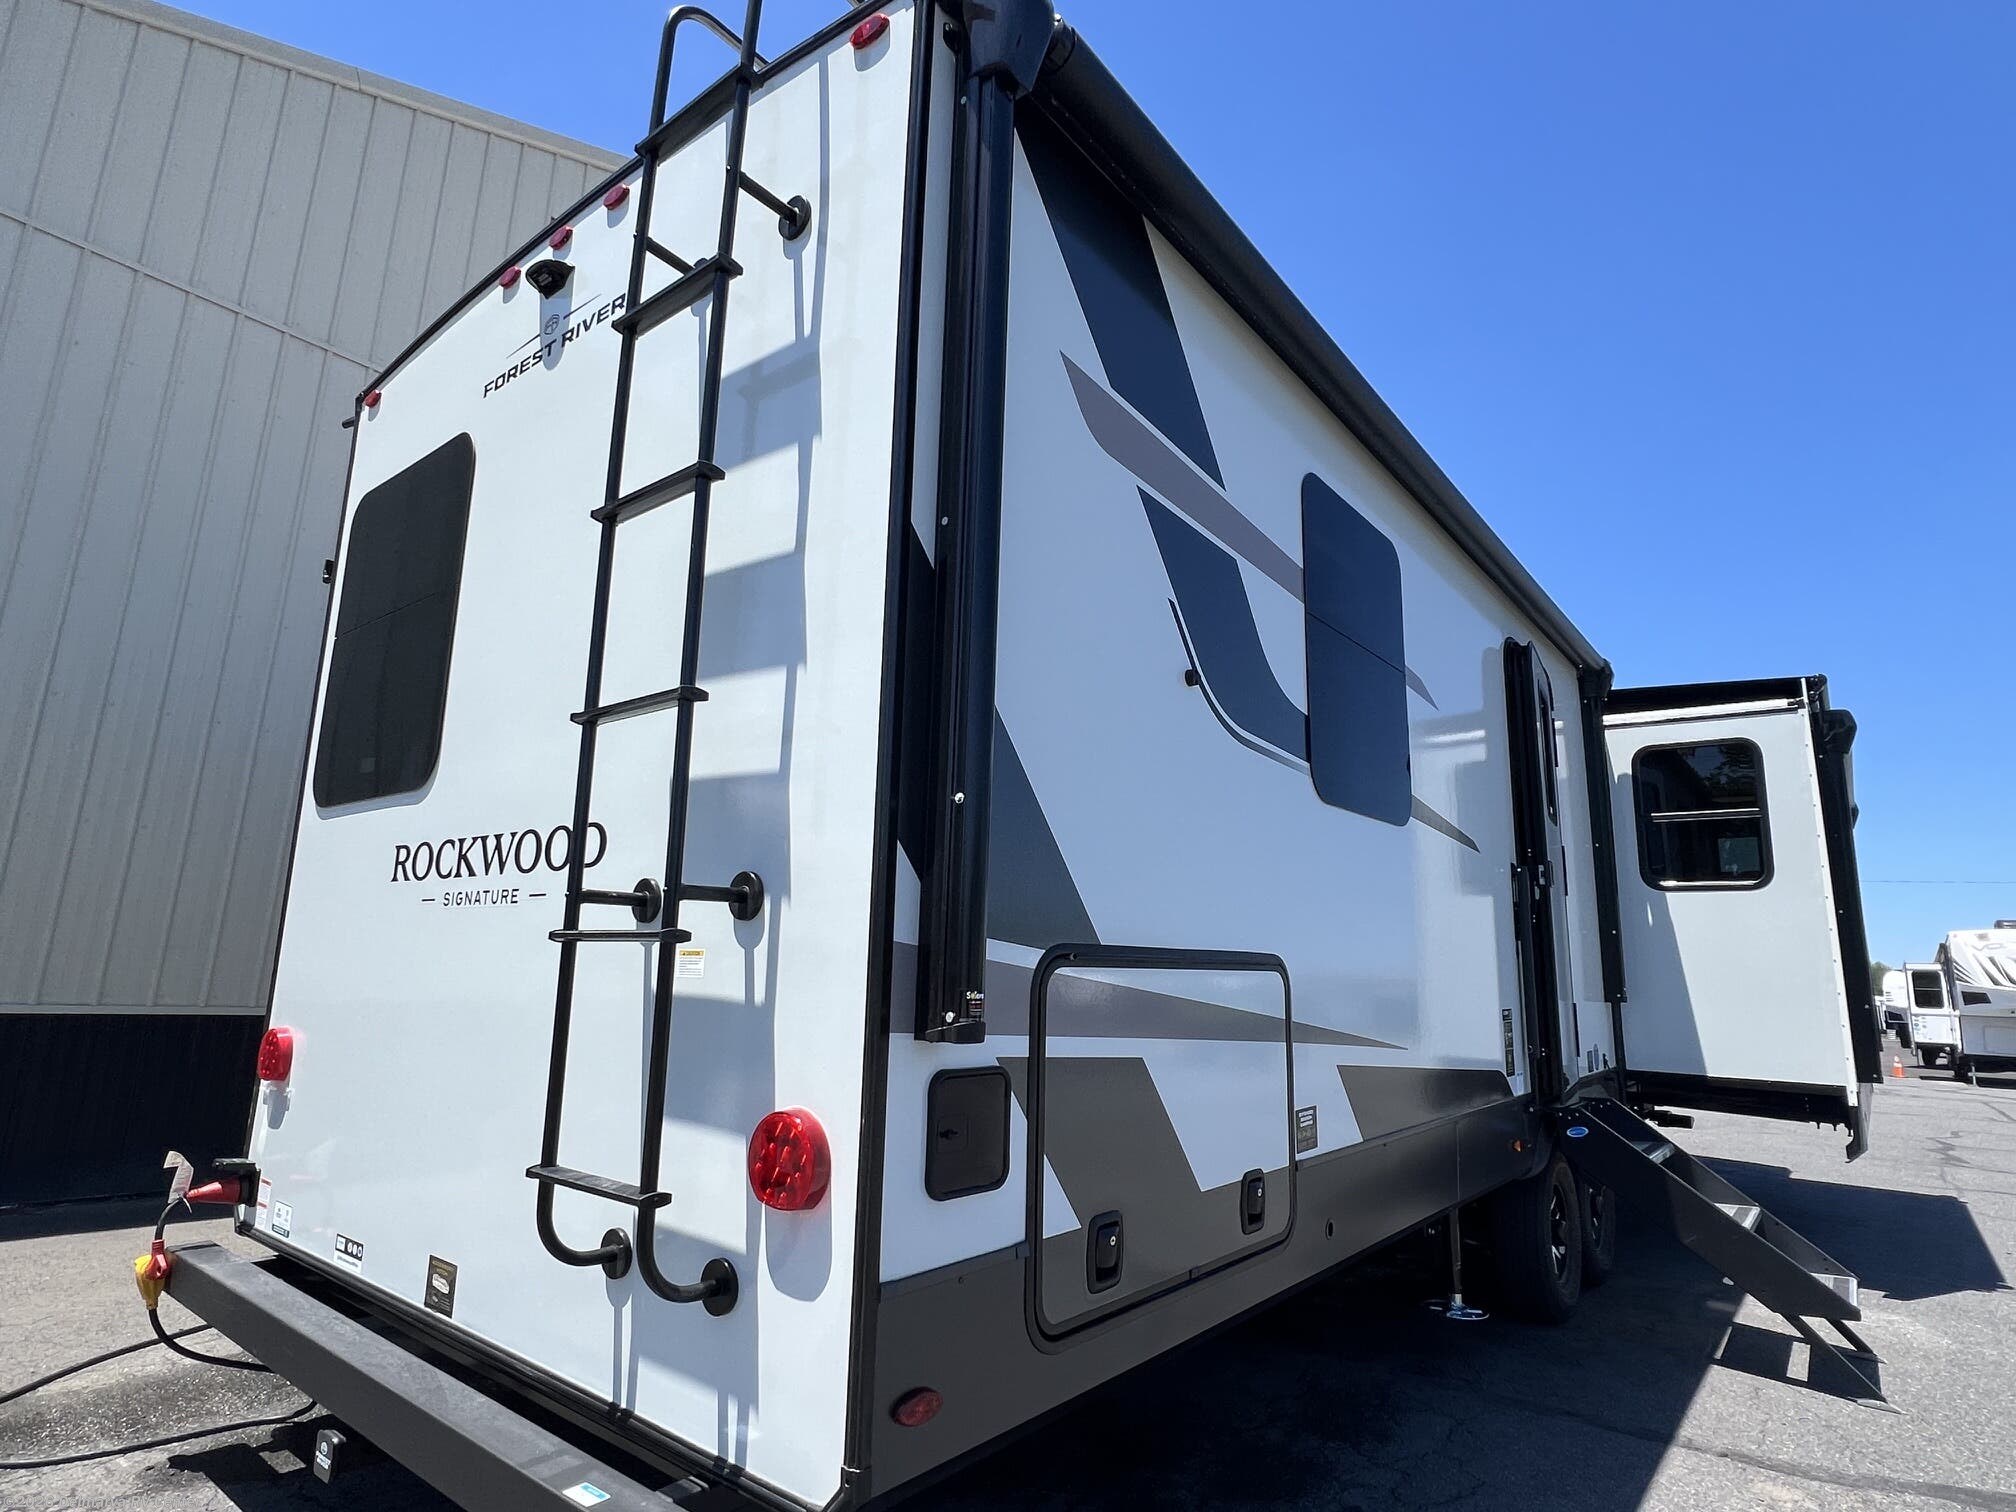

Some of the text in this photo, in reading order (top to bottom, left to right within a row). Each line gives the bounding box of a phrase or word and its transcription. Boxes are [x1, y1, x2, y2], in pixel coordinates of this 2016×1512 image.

[483, 293, 626, 399] FOREST RIVER
[390, 822, 608, 882] ROCKWOOD
[443, 888, 520, 907] SIGNATURE
